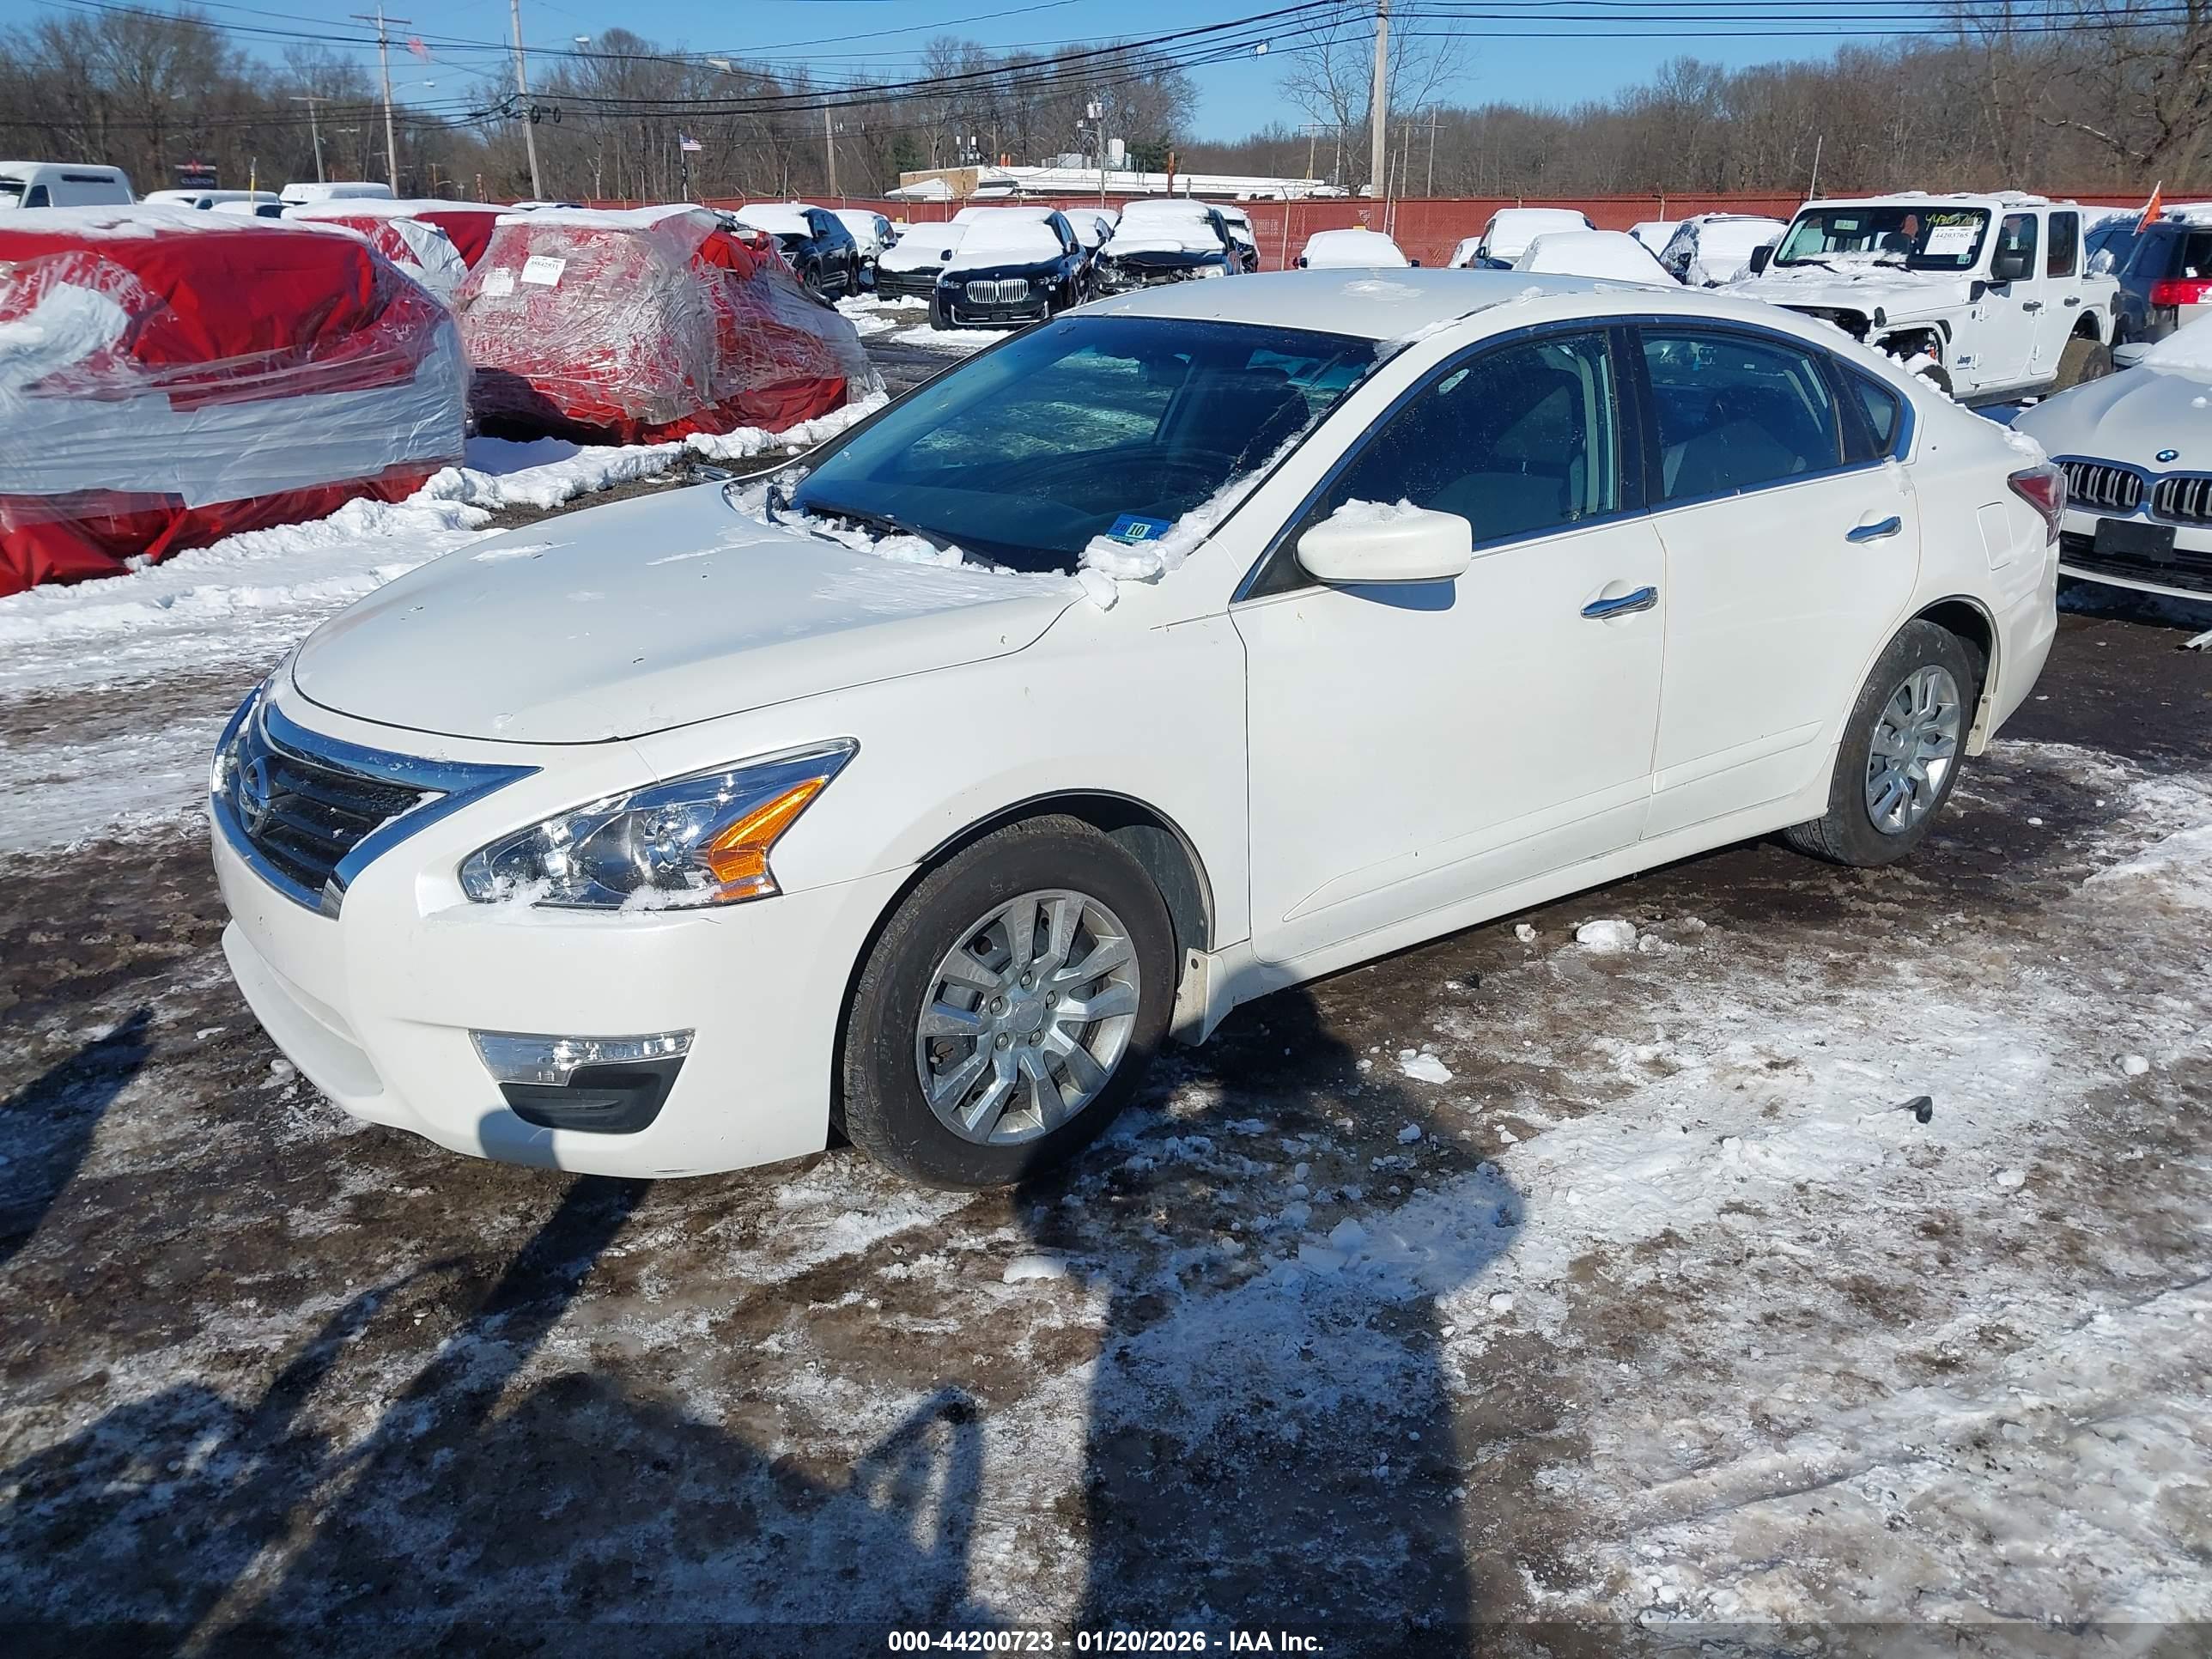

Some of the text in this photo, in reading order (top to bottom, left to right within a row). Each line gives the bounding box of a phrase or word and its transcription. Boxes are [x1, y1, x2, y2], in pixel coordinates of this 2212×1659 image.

[1957, 354, 1972, 366] Jeep
[1115, 523, 1127, 532] 20
[1127, 525, 1145, 537] 10
